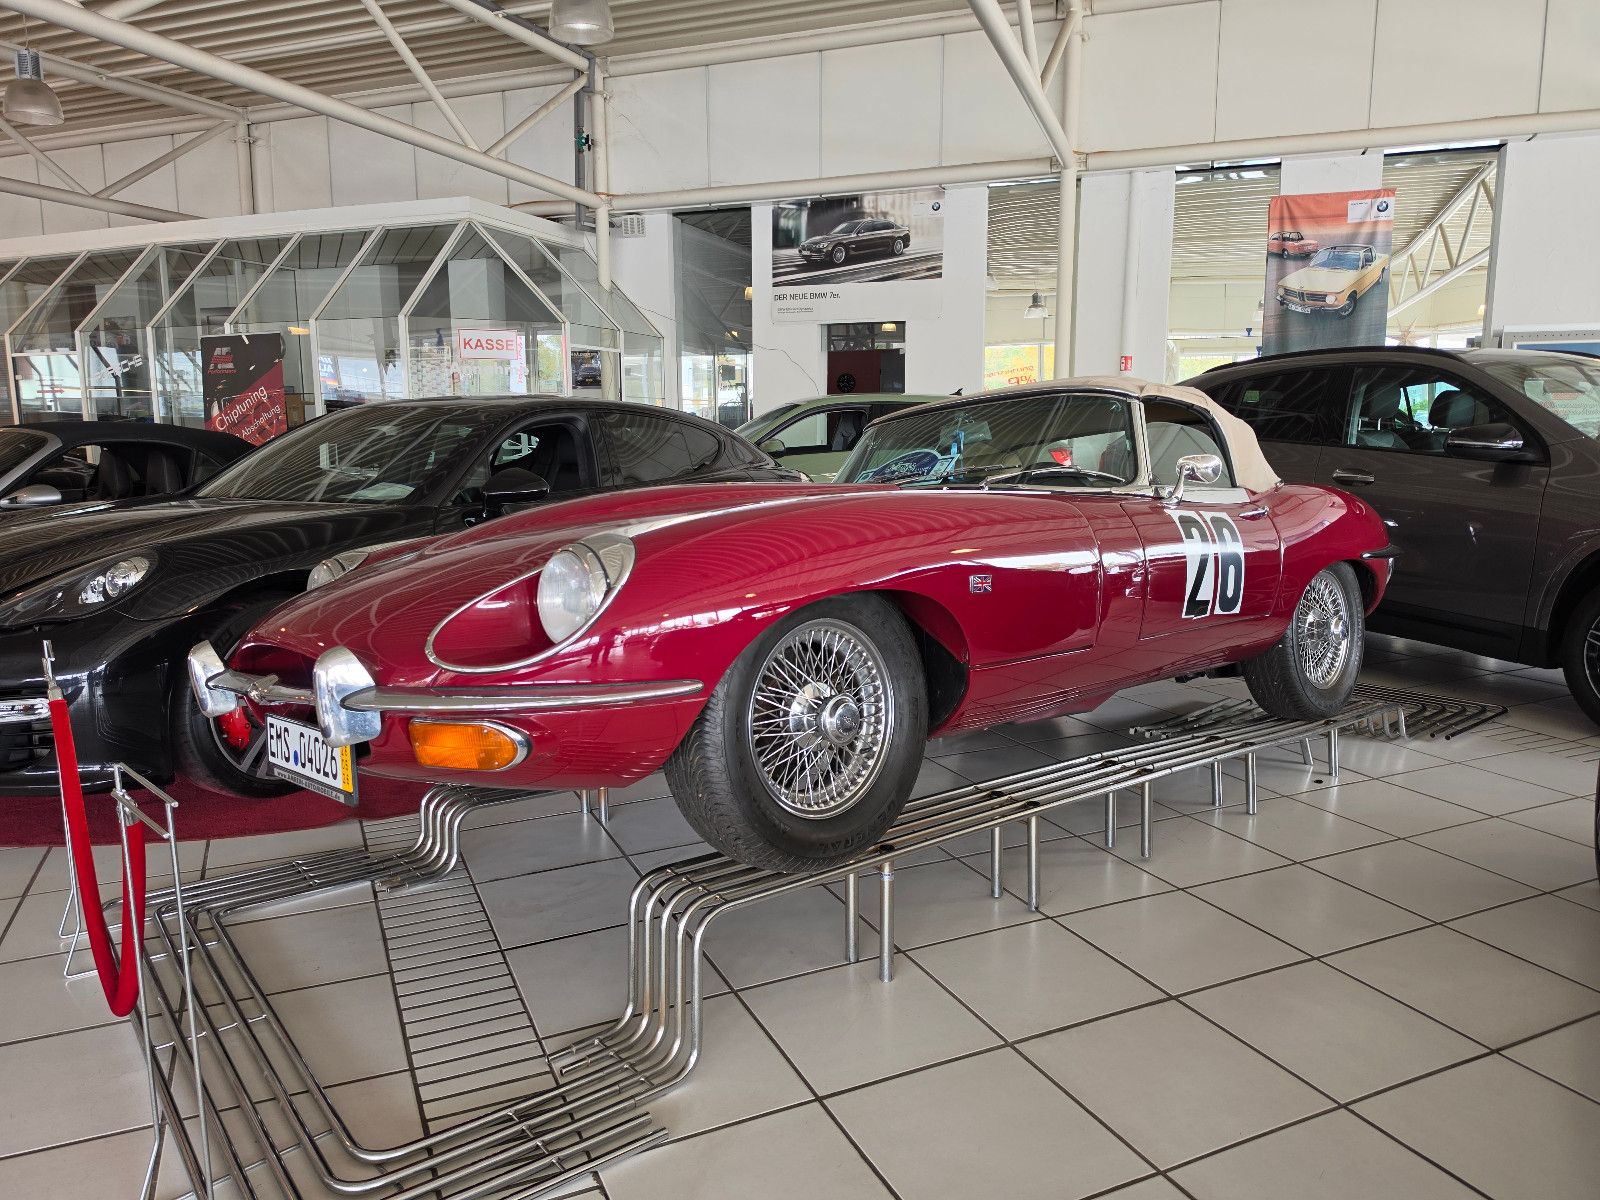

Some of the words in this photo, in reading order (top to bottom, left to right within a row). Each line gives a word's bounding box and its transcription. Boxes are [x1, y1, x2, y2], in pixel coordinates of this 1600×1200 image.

[809, 292, 828, 300] BMW
[463, 338, 515, 351] KASSE
[215, 386, 268, 431] Chiptuning
[242, 405, 281, 439] Abschaltung
[269, 722, 291, 764] EMS
[300, 731, 338, 781] 04026
